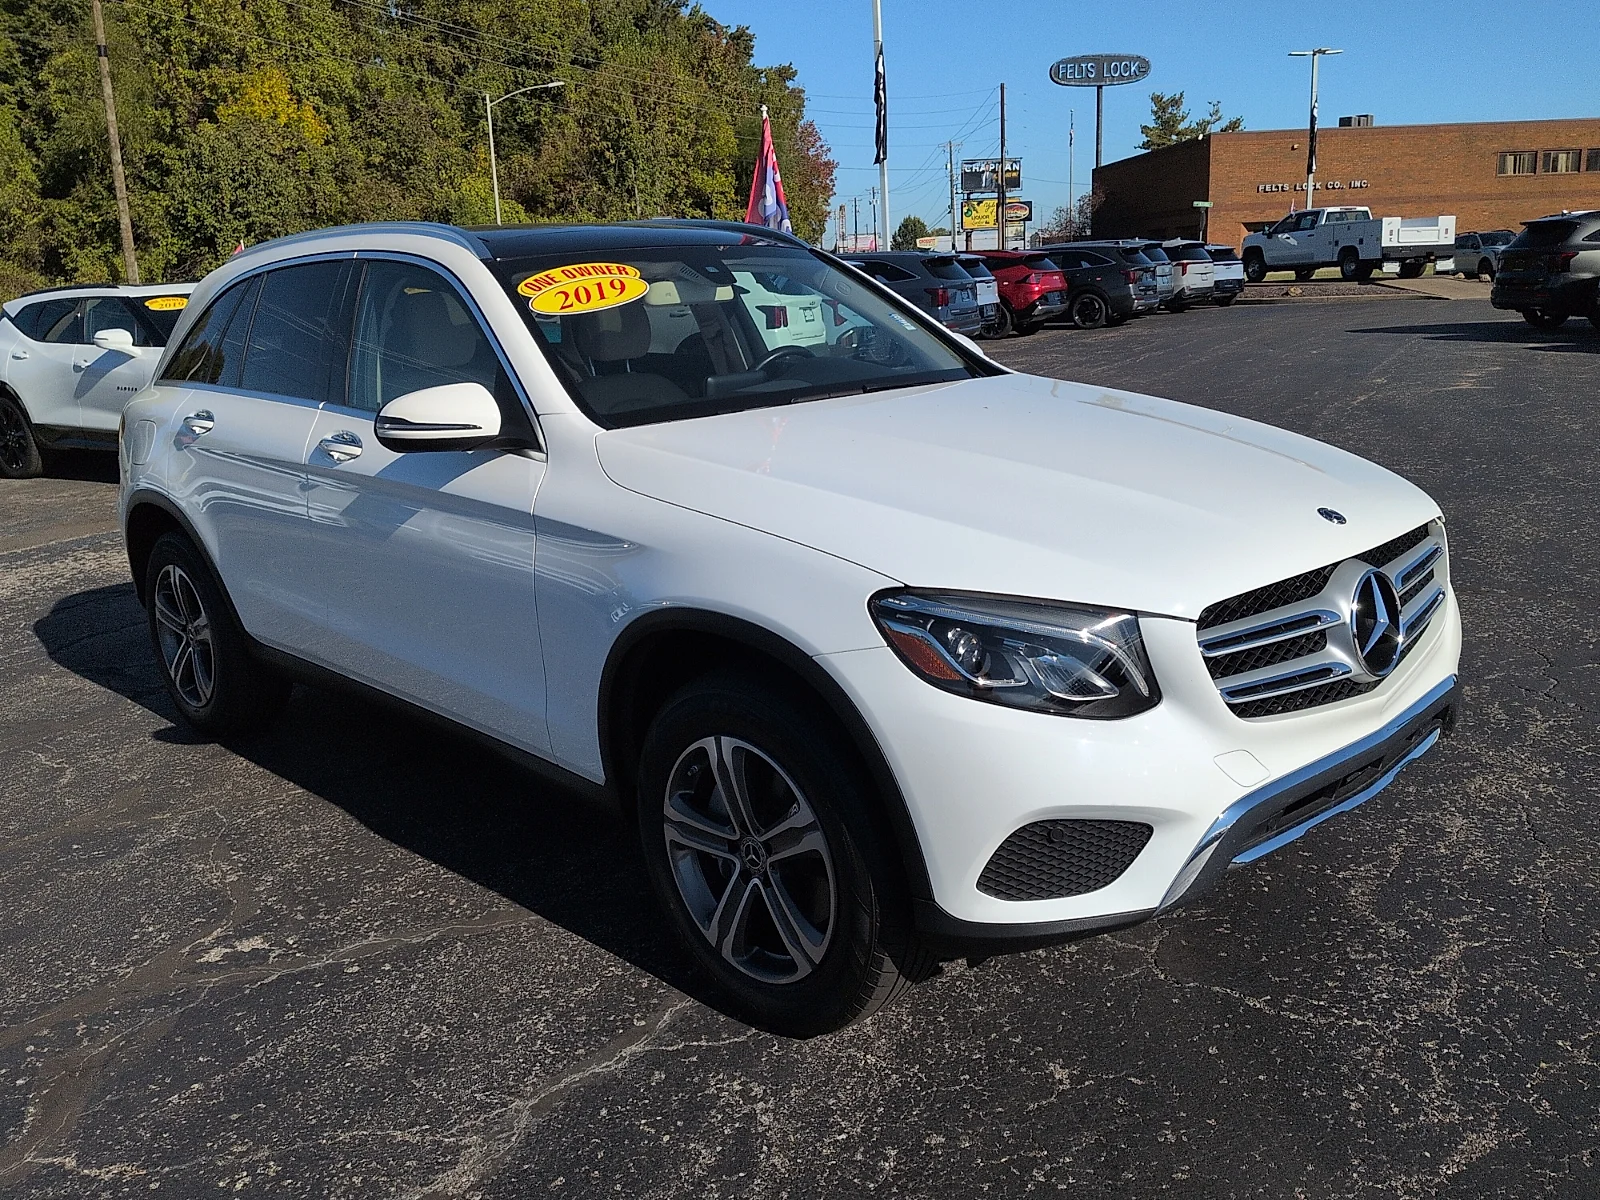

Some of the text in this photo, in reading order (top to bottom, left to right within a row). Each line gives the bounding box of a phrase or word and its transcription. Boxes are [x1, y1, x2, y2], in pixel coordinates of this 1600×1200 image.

[1059, 62, 1096, 79] FELTS
[1103, 61, 1140, 77] LOCK
[964, 162, 1020, 173] CHAPAN
[1258, 183, 1289, 193] FELTS
[1350, 180, 1371, 188] INC.
[524, 265, 629, 292] ONE OWNER
[554, 278, 626, 310] 2019
